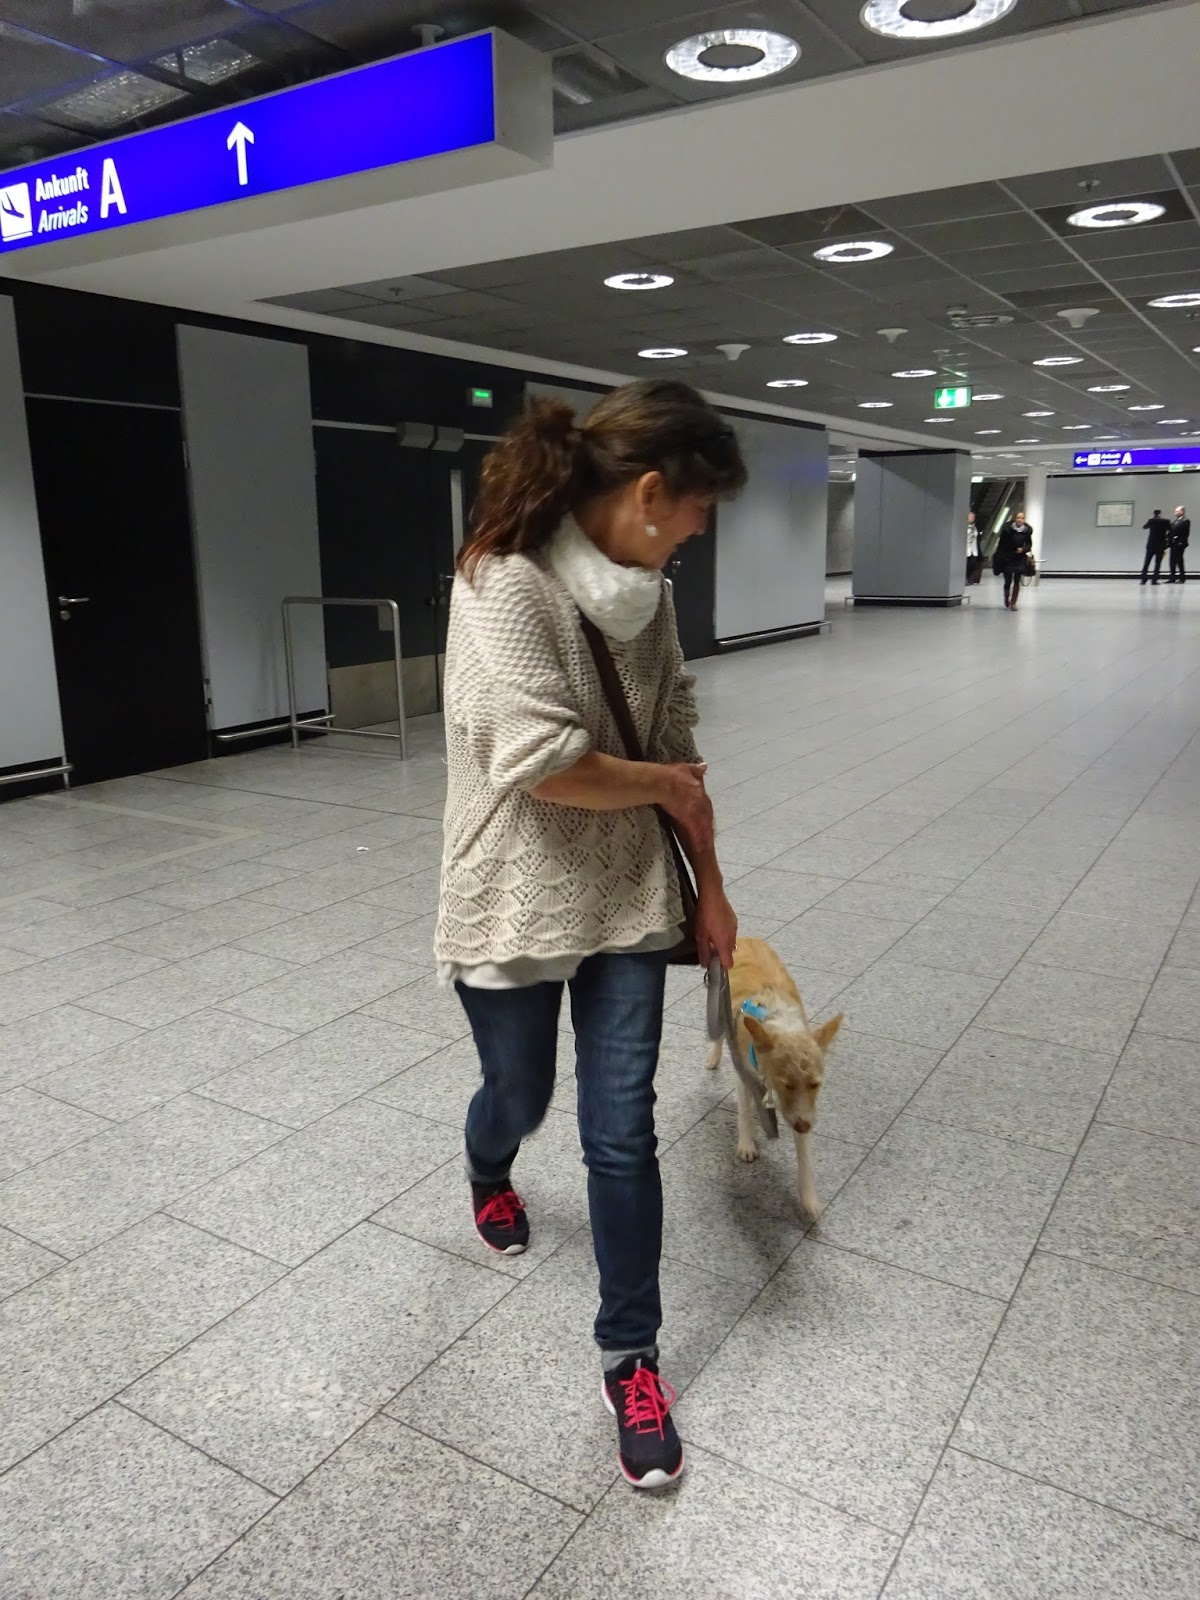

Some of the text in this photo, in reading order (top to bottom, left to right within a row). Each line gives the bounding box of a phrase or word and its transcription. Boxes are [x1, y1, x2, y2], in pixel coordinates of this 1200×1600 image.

[36, 167, 90, 202] Ankunft
[100, 158, 127, 219] A
[37, 201, 89, 233] Arrivals
[1121, 452, 1132, 465] A
